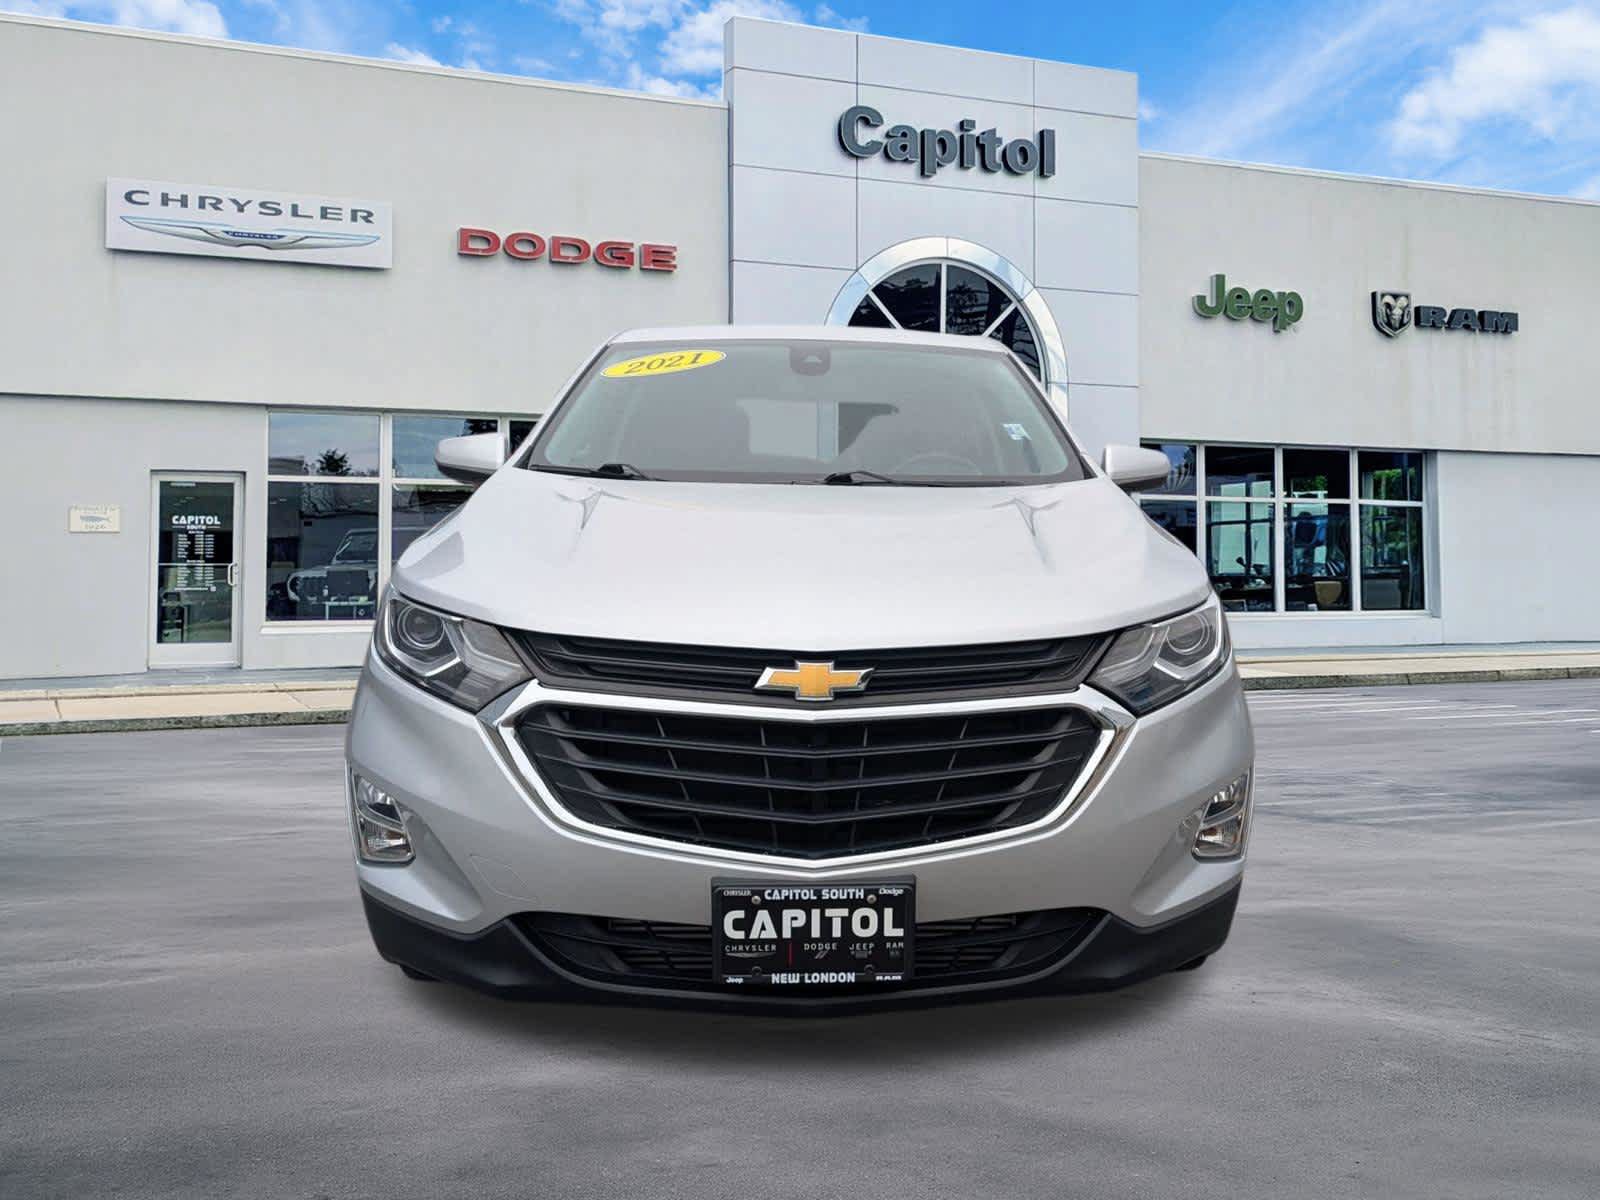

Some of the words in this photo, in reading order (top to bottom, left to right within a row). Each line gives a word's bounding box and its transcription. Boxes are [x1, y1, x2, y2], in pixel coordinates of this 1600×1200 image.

[838, 105, 1056, 178] Capitol
[123, 189, 375, 224] CHRYSLER
[457, 227, 678, 272] DODGE
[1192, 274, 1304, 333] Jeep
[1414, 305, 1519, 333] RAM
[624, 352, 703, 375] 2021
[172, 515, 221, 525] CAPITOL
[764, 889, 817, 900] CAPITOL
[821, 888, 865, 900] SOUTH
[879, 887, 904, 896] Dodge
[723, 907, 905, 939] CAPITOL
[724, 944, 777, 952] CHRYSLER
[803, 942, 837, 951] DODGE
[849, 942, 875, 951] JEEP
[886, 941, 904, 949] RAM
[771, 972, 800, 984] NEW
[804, 971, 856, 984] LONDON
